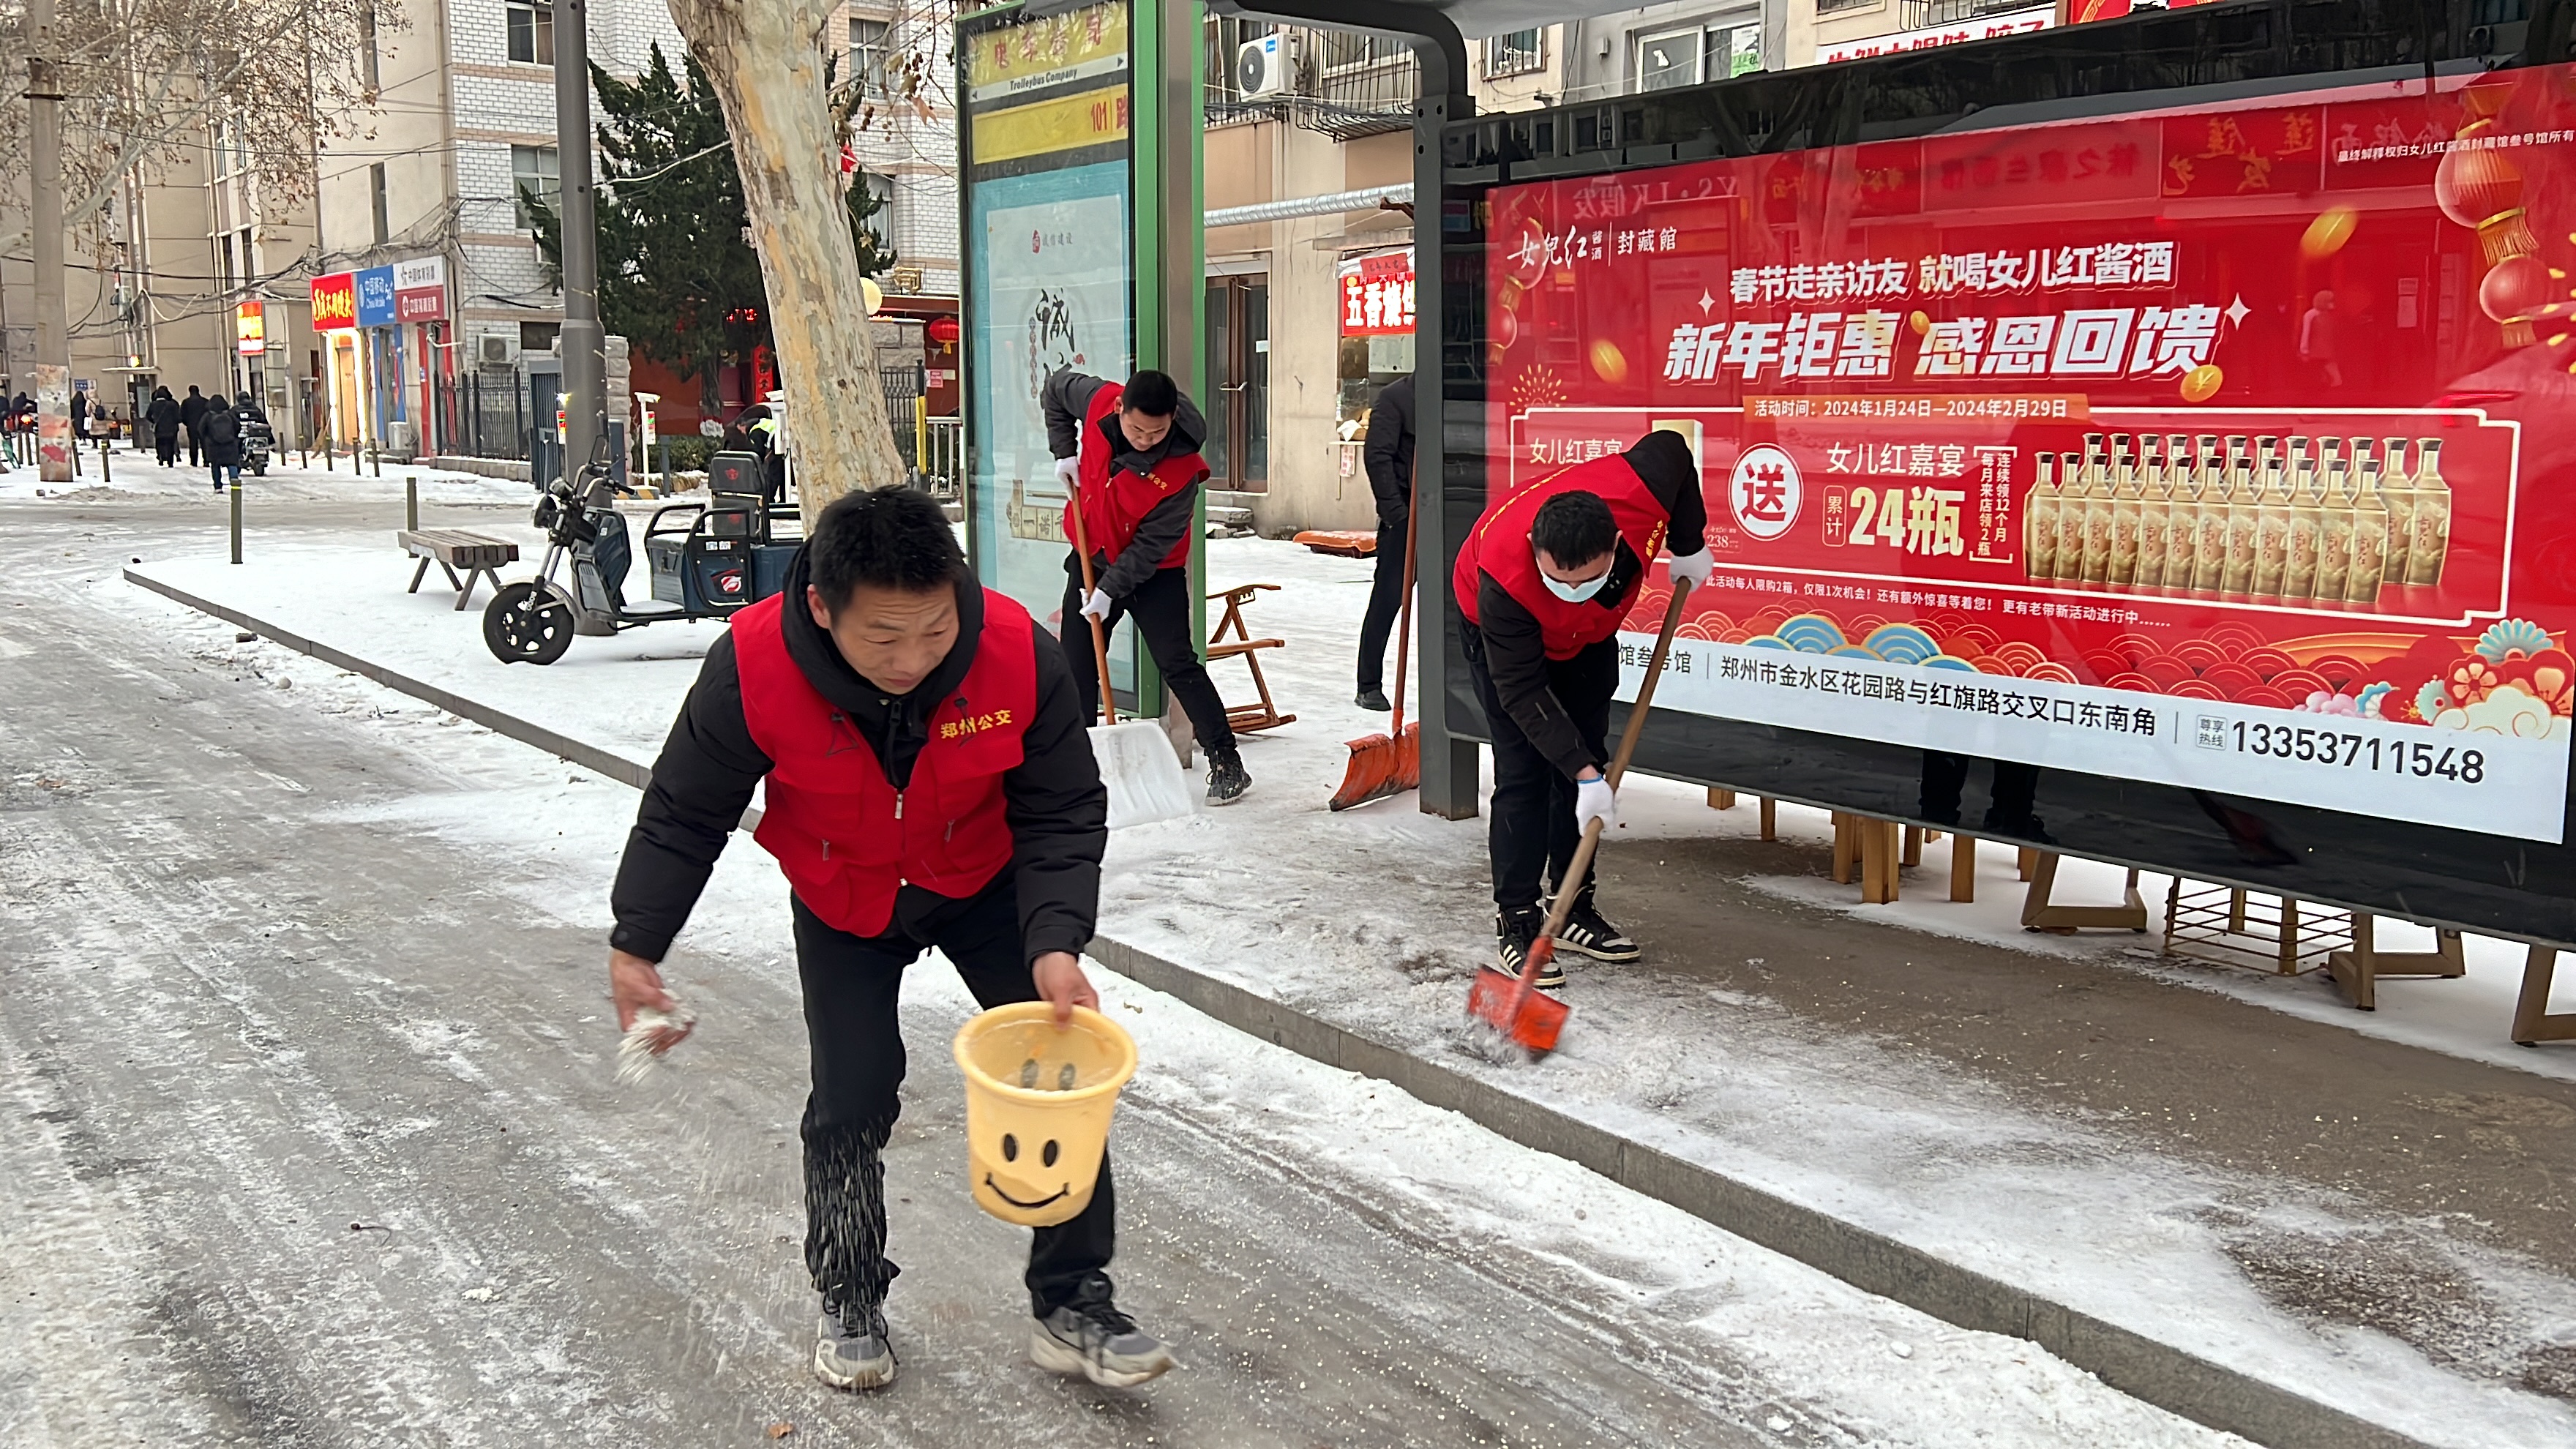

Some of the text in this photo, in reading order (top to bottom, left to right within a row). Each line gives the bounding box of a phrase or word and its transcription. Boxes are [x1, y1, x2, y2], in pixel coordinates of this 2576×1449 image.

[1010, 67, 1077, 91] Trolleybus Company
[1090, 102, 1107, 133] 101
[1730, 242, 2174, 304] 春节走亲访友 就喝女儿红酱酒
[1663, 304, 2221, 381] 新年钜惠 感恩回馈
[1826, 441, 1966, 476] 女儿红嘉宴
[1741, 463, 1786, 523] 送
[1826, 495, 1843, 537] 累计
[1849, 485, 1966, 556] 24瓶
[940, 708, 1014, 740] 郑州公交
[1721, 655, 2157, 737] 郑州市金水区花园路与红旗路交叉口东南角
[2232, 720, 2485, 784] 13353711548
